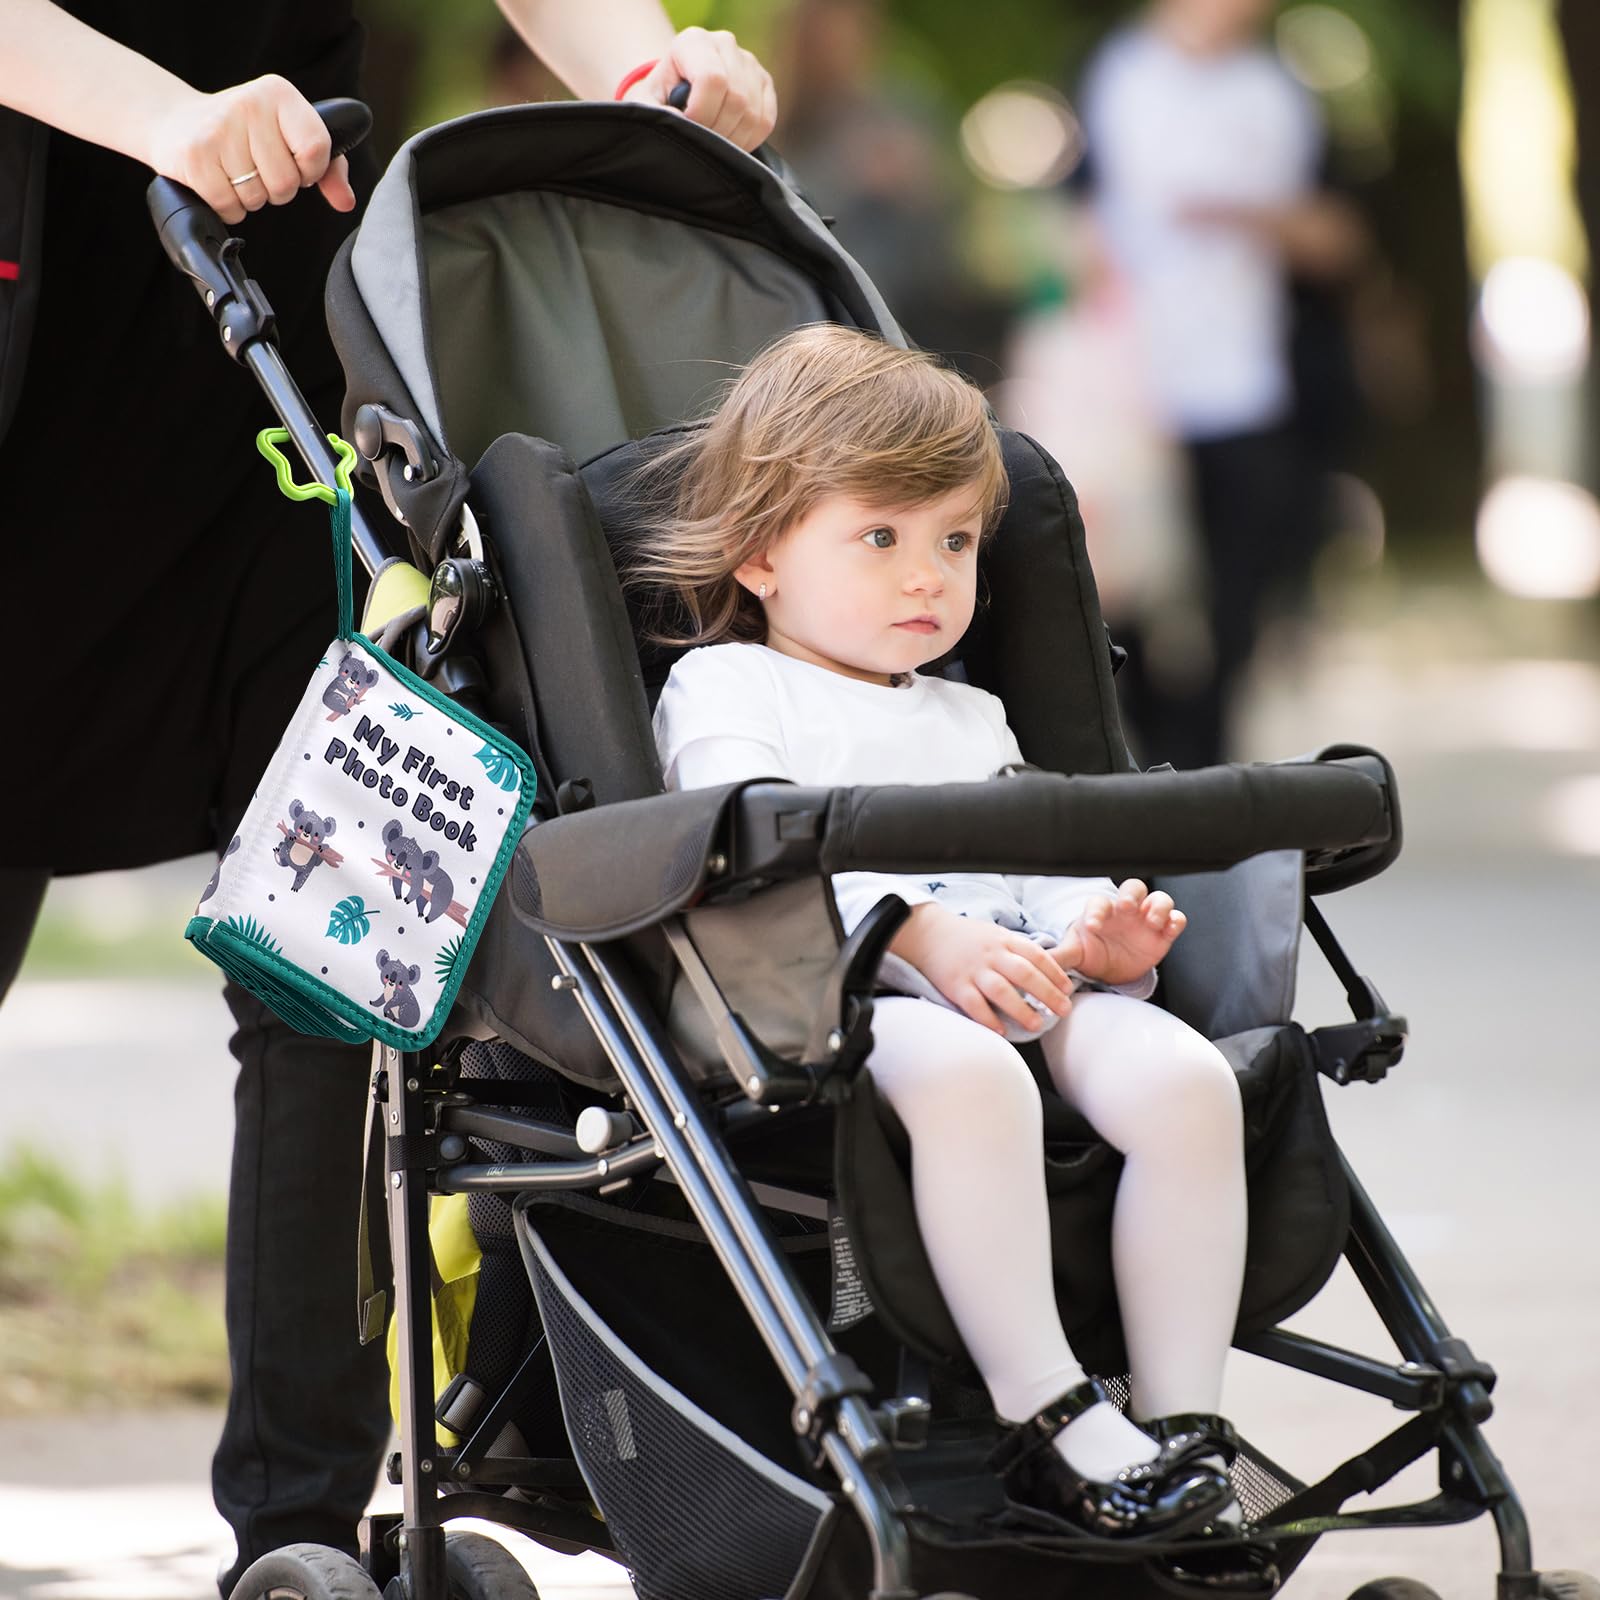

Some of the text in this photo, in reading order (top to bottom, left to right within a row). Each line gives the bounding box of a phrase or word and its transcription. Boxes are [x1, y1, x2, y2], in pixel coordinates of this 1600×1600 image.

[324, 737, 477, 852] Photo Book
[353, 715, 474, 810] My First
